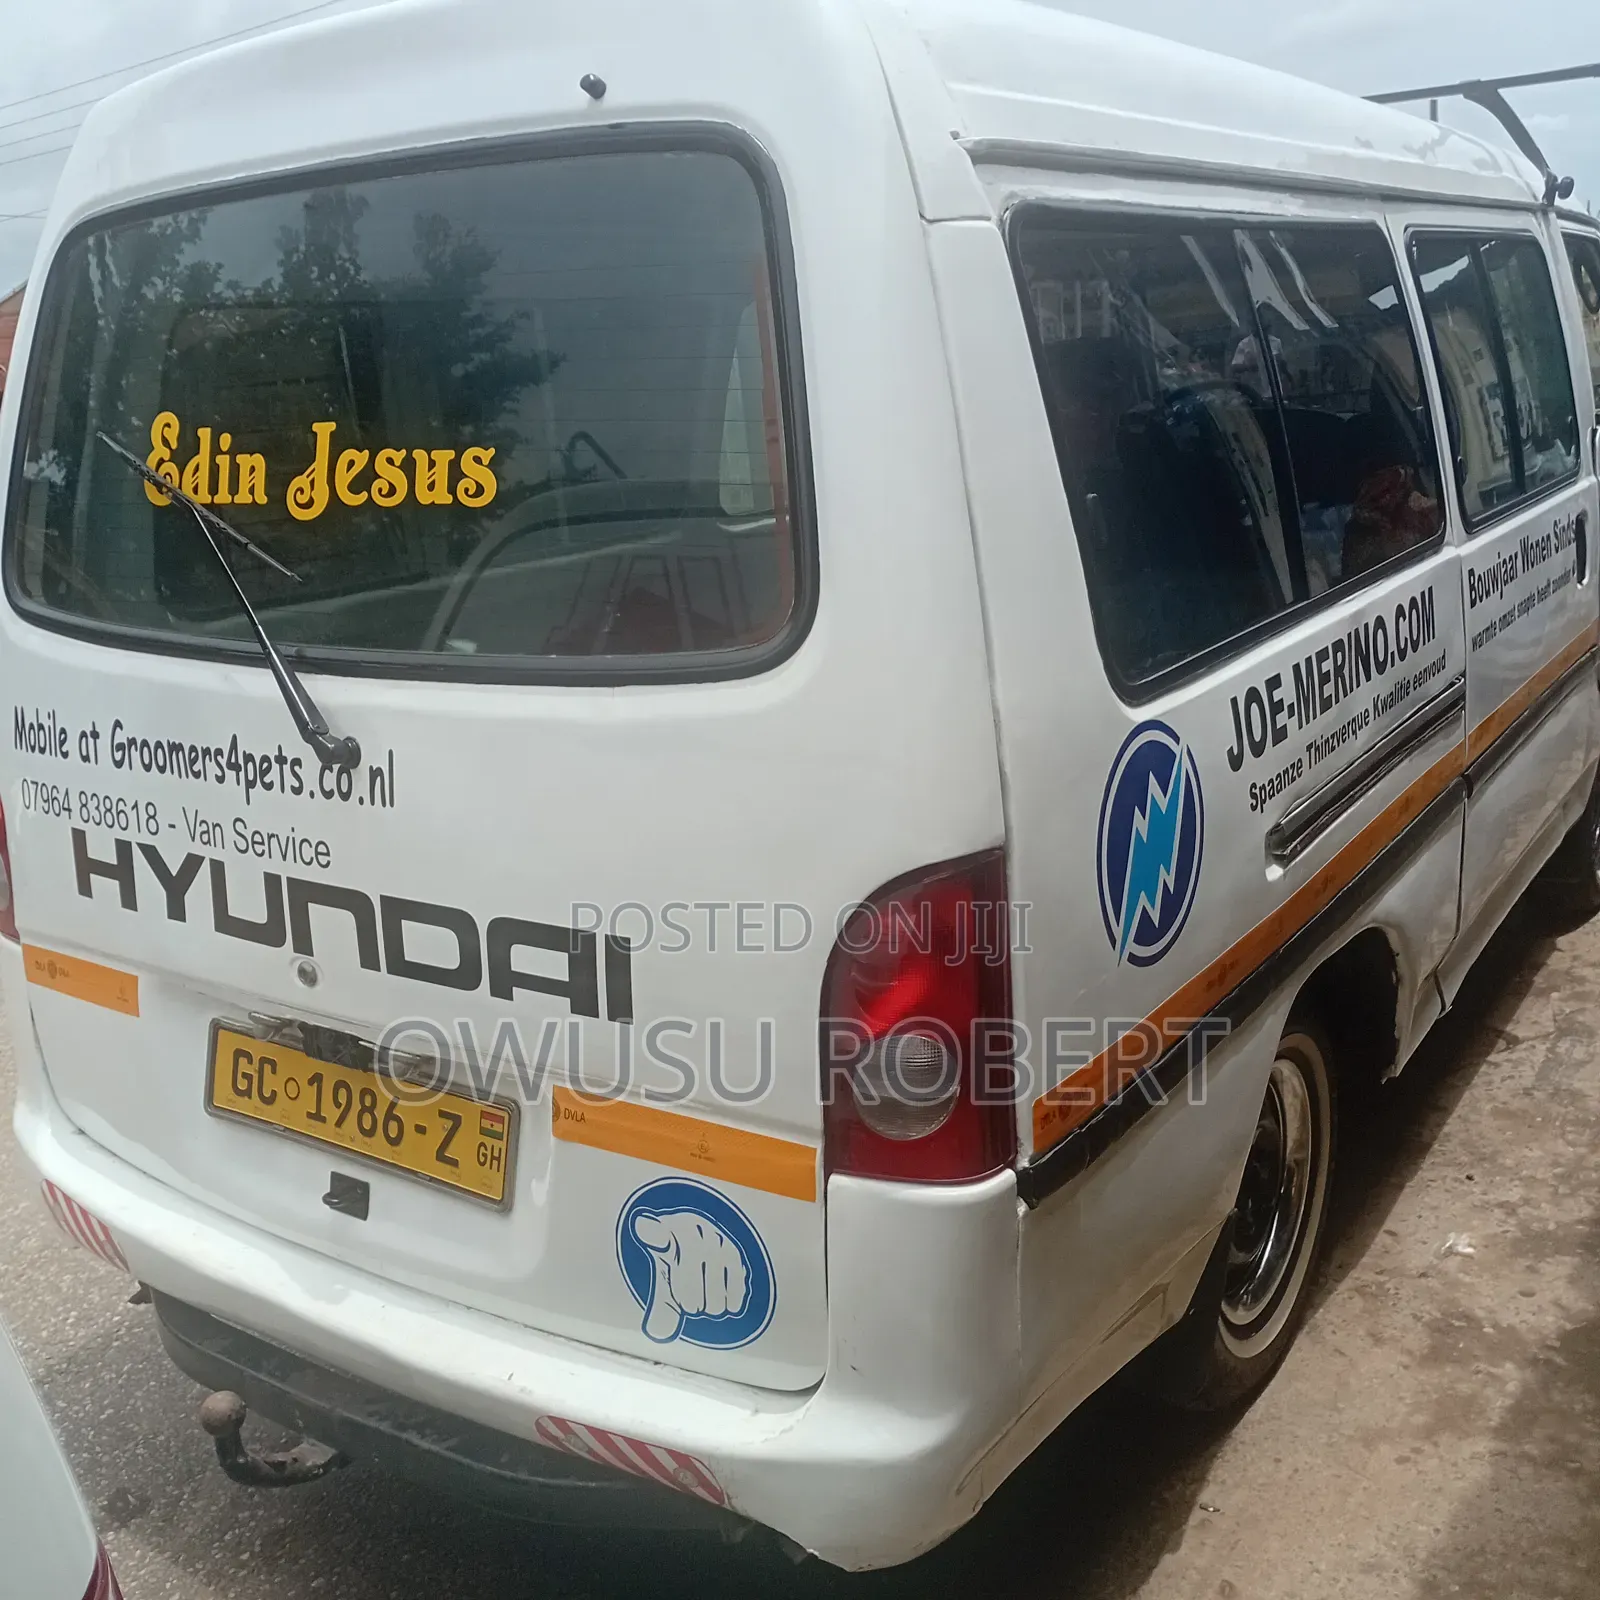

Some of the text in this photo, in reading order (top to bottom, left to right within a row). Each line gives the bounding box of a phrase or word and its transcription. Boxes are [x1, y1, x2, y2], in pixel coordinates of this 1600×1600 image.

[144, 411, 498, 522] Edin Jesus
[1467, 551, 1519, 610] Bouwjaar
[1519, 534, 1552, 575] Wonen
[1226, 585, 1437, 774] JOE-MERINO.COM
[1249, 648, 1447, 815] Spaanze Thinzverque Kwalitie eenvoud
[14, 705, 396, 808] Mobile at Groomers4pets.co.nl
[21, 778, 72, 820] 07964
[79, 791, 160, 836] 838618
[182, 806, 225, 850] Van
[232, 816, 332, 869] Service
[71, 827, 634, 1026] HYUNDAI
[231, 1048, 460, 1168] GC 1986-Z
[476, 1141, 503, 1174] GH
[563, 1107, 586, 1123] DVLA
